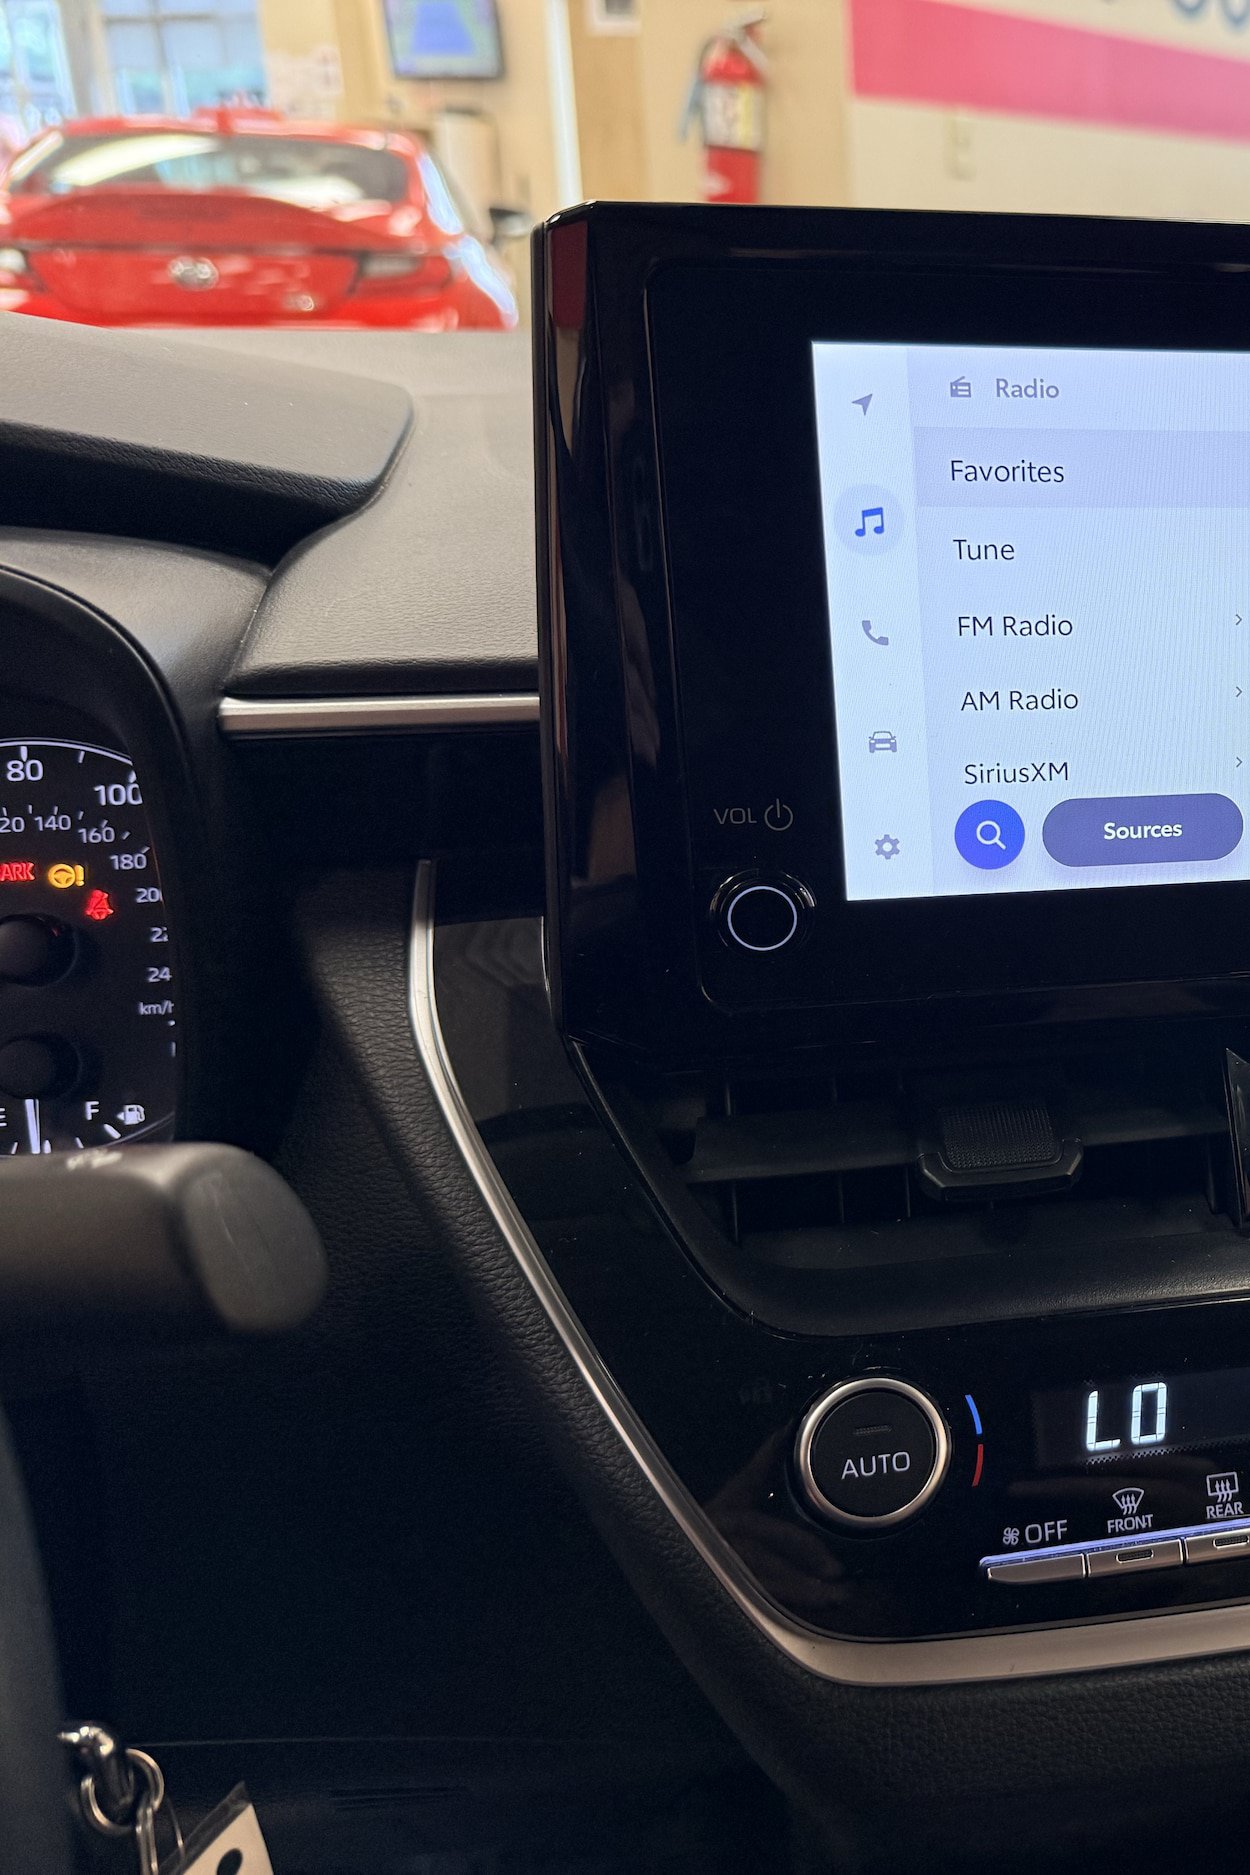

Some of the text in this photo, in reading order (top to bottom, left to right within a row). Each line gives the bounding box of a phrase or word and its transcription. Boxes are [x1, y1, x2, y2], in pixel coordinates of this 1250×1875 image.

[995, 377, 1060, 399] Radio
[951, 459, 1065, 483] Favorites
[952, 539, 1015, 561] Tune
[958, 614, 1073, 637] FM Radio
[960, 688, 1079, 711] AM Radio
[6, 759, 44, 782] 80
[964, 761, 1068, 785] SiriusXM
[93, 783, 143, 806] 100
[0, 816, 25, 833] 20
[34, 814, 72, 831] 140
[713, 808, 758, 825] VOL
[78, 826, 116, 844] 160
[1103, 822, 1183, 840] Sources
[0, 862, 36, 882] ARK
[109, 853, 147, 870] 180
[134, 886, 163, 903] 20
[147, 966, 172, 982] 24
[85, 1100, 100, 1121] F
[1085, 1381, 1168, 1452] LO
[841, 1451, 911, 1480] AUTO
[1206, 1501, 1244, 1519] REAR
[1024, 1519, 1069, 1545] OFF
[1107, 1513, 1154, 1535] FRONT
